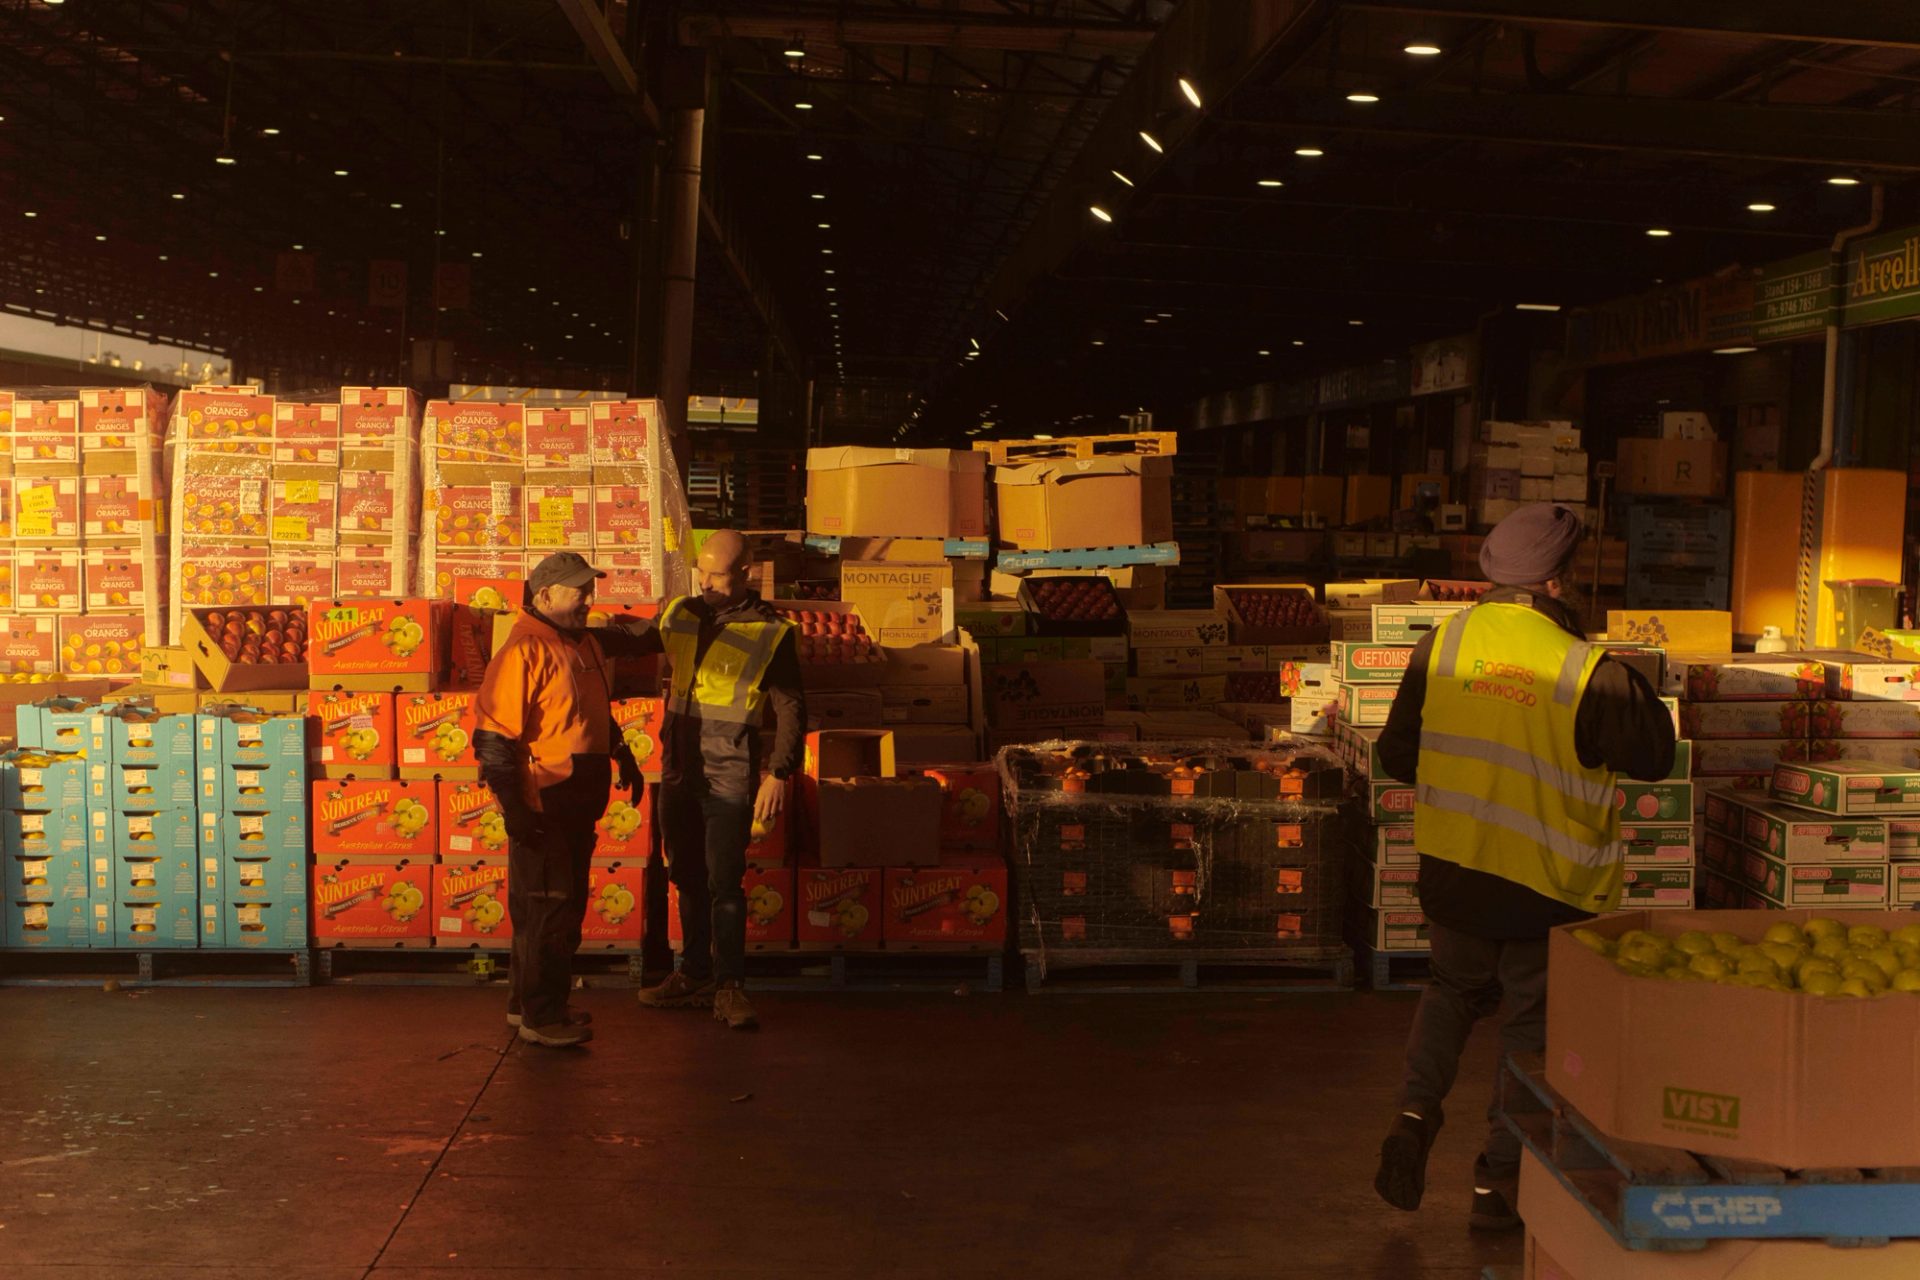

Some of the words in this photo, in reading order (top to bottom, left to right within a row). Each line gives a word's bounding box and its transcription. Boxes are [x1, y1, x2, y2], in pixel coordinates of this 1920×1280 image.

[204, 406, 248, 417] ORANGES
[454, 416, 498, 425] ORANGES
[95, 423, 130, 431] ORANGES
[540, 442, 575, 450] ORANGES
[199, 488, 241, 498] ORANGE
[453, 500, 493, 509] ORANGE
[96, 509, 130, 517] ORANGES
[198, 559, 242, 568] ORANGES
[453, 566, 498, 576] ORANGES
[352, 579, 387, 587] ORANGES
[843, 572, 933, 584] MONTAGUE
[100, 581, 135, 589] ORANGES
[334, 610, 354, 621] 41
[84, 628, 129, 637] ORANGES
[882, 631, 929, 639] MONTAGUE
[1134, 629, 1195, 639] MONTAGUE
[5, 649, 40, 657] ORANGES
[1473, 659, 1535, 686] ROGERS
[1751, 670, 1786, 679] Premium
[1462, 679, 1537, 707] KIRKWOOD
[317, 693, 383, 721] SUNTREAT
[405, 694, 470, 726] SUNTREAT
[1017, 703, 1104, 721] MONTAGUE
[1735, 708, 1770, 718] Premium
[320, 789, 391, 822] SUNTREAT
[442, 866, 507, 896] SUNTREAT
[316, 872, 386, 904] SUNTREAT
[806, 871, 871, 902] SUNTREAT
[891, 875, 963, 908] SUNTREAT
[472, 962, 490, 973] 41
[1669, 1091, 1736, 1123] VISY
[1689, 1196, 1783, 1225] CHEP
